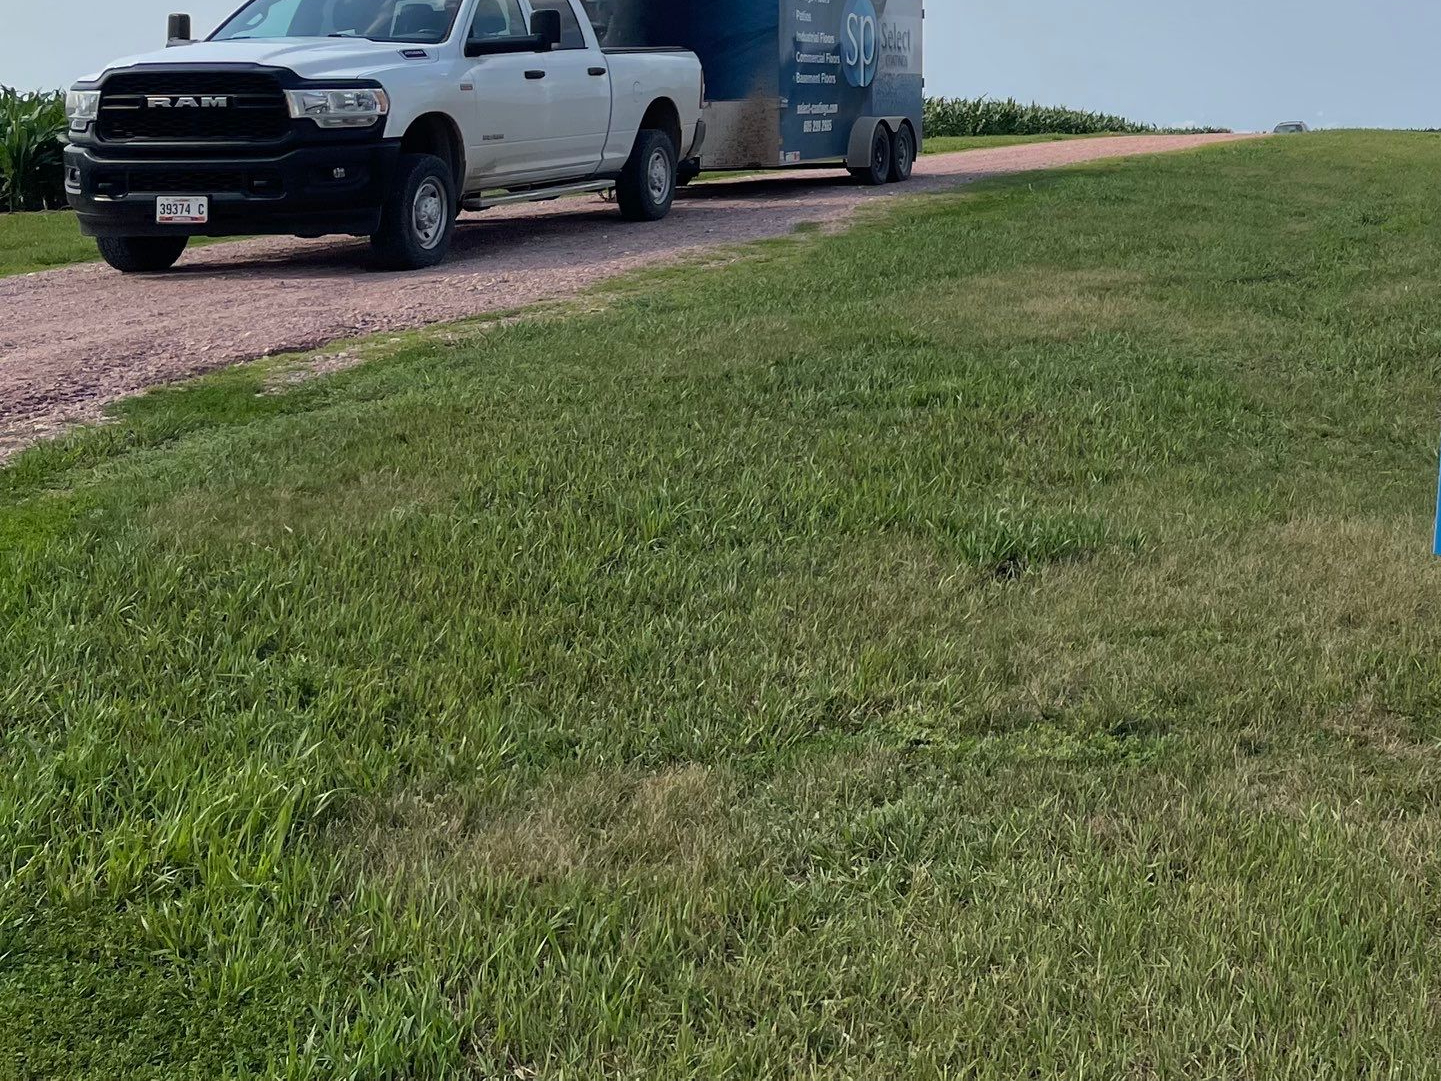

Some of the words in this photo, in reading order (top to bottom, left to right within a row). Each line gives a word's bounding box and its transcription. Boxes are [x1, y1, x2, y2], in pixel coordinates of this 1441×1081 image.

[796, 31, 819, 43] Industrial
[820, 33, 835, 44] Floors
[881, 22, 911, 53] Select
[796, 51, 825, 64] Commercial
[826, 52, 841, 64] Floors
[821, 72, 836, 85] Floors
[147, 96, 227, 108] RAM
[160, 203, 191, 215] 39374
[198, 203, 205, 215] C
